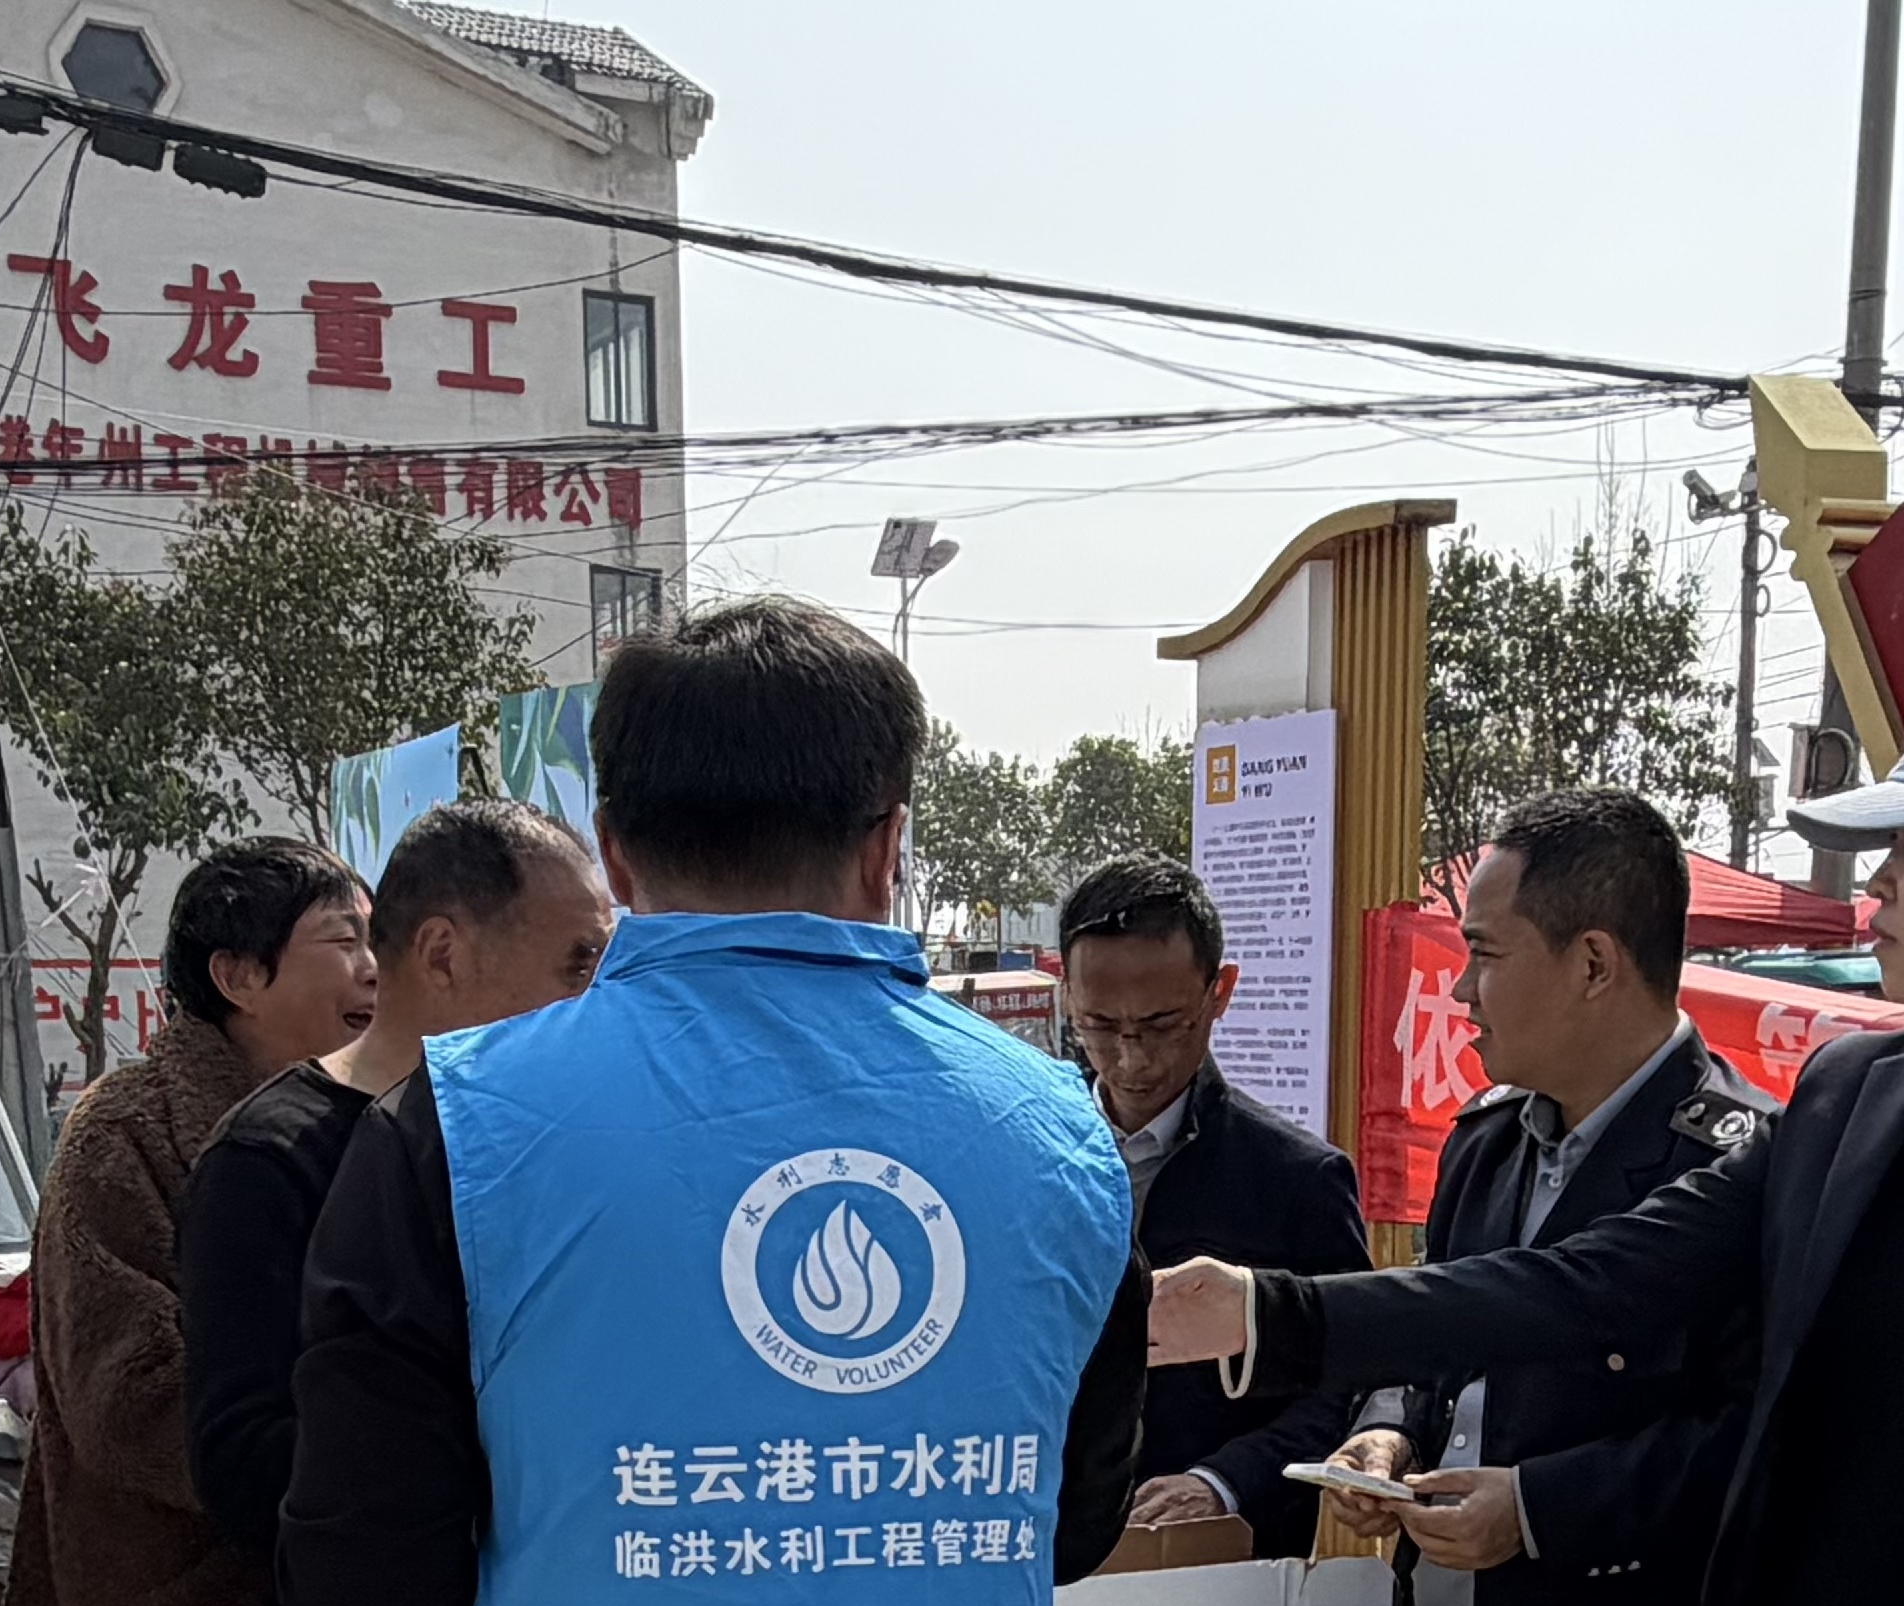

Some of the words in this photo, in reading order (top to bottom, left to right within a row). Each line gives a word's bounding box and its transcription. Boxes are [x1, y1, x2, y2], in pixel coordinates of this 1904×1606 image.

[7, 253, 525, 396] 飞龙重工
[1393, 968, 1482, 1110] 依
[754, 1322, 820, 1380] WATER
[834, 1317, 945, 1387] VOLUNTEER
[612, 1432, 1040, 1508] 连云港市水利局
[614, 1516, 1037, 1580] 临洪水利工程管理处
